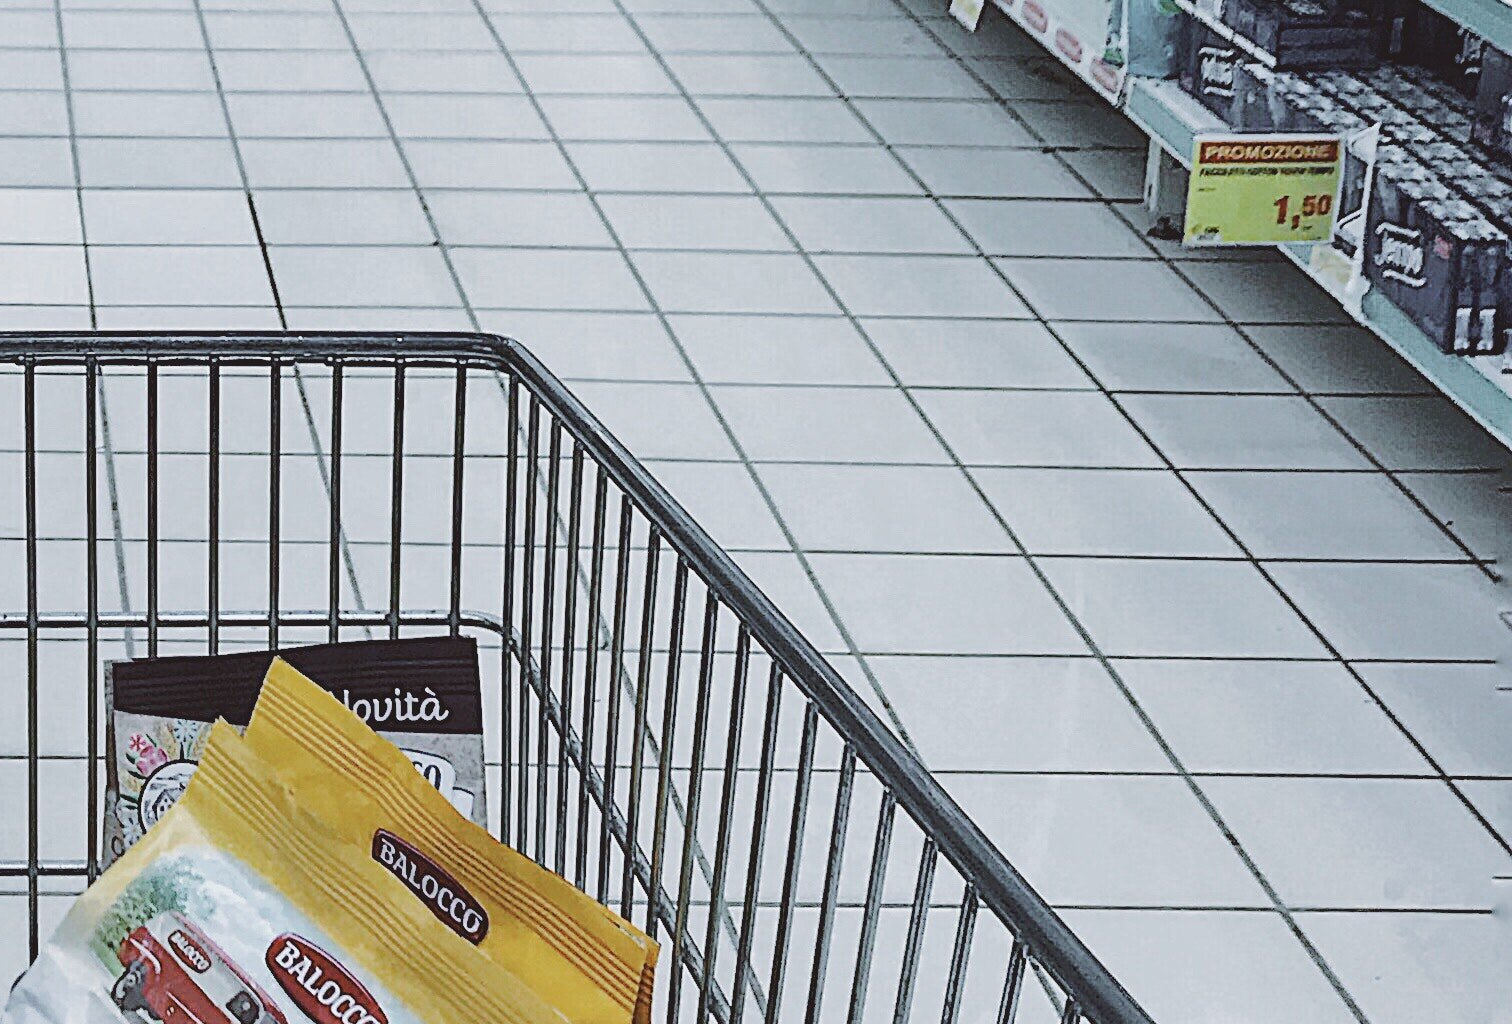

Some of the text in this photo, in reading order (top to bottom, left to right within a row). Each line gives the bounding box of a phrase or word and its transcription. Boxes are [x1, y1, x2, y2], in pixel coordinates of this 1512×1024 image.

[1205, 144, 1333, 160] PROMOZIONE
[1273, 194, 1333, 230] 1,50
[378, 838, 484, 934] BALOCCO
